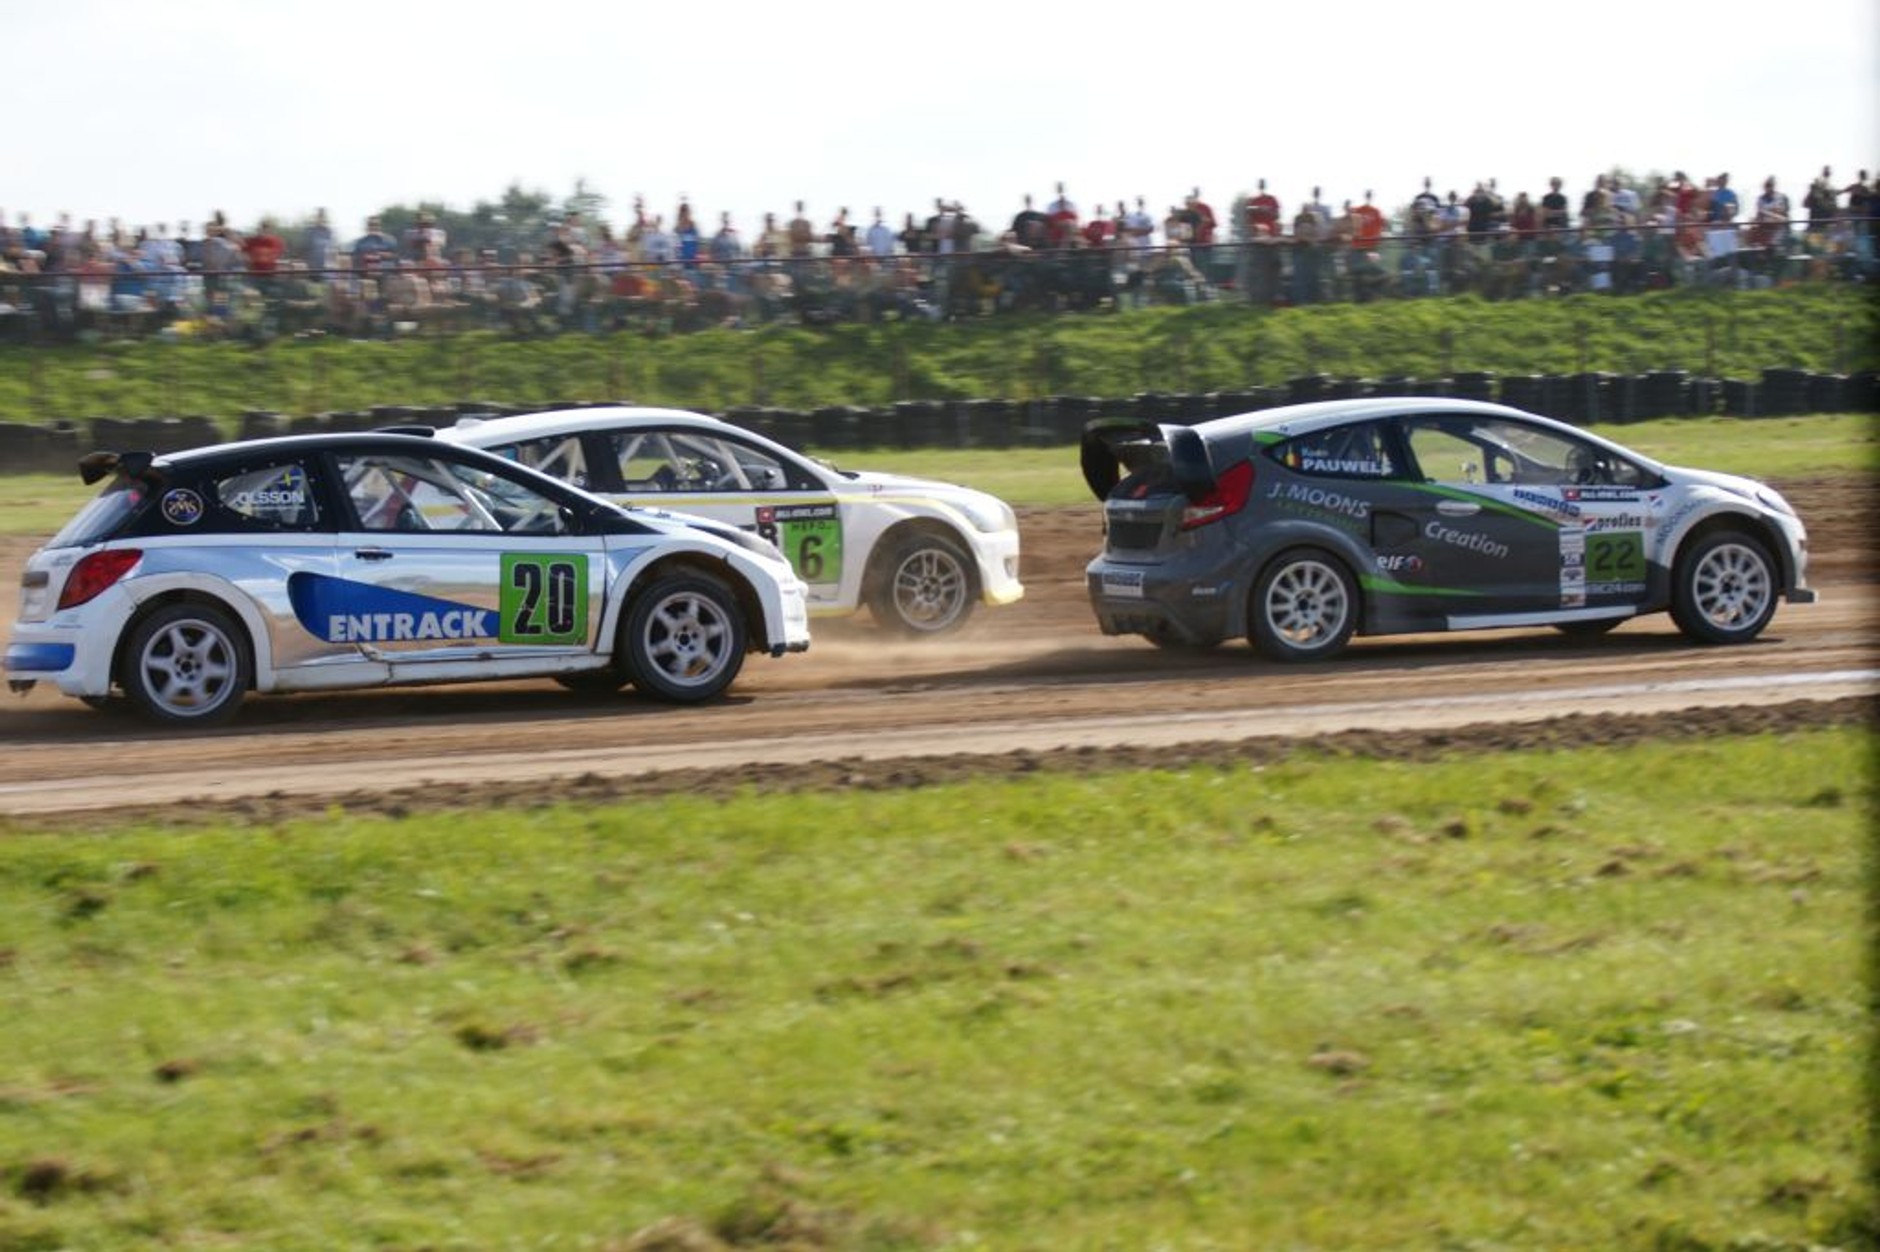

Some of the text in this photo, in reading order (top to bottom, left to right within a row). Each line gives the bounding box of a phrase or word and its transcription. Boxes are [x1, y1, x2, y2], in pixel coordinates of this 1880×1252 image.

[1425, 521, 1509, 557] Creation
[800, 535, 824, 579] 6
[1376, 556, 1405, 571] elf
[1594, 541, 1636, 572] 22
[514, 563, 575, 635] 20
[329, 611, 488, 642] ENTRACK
